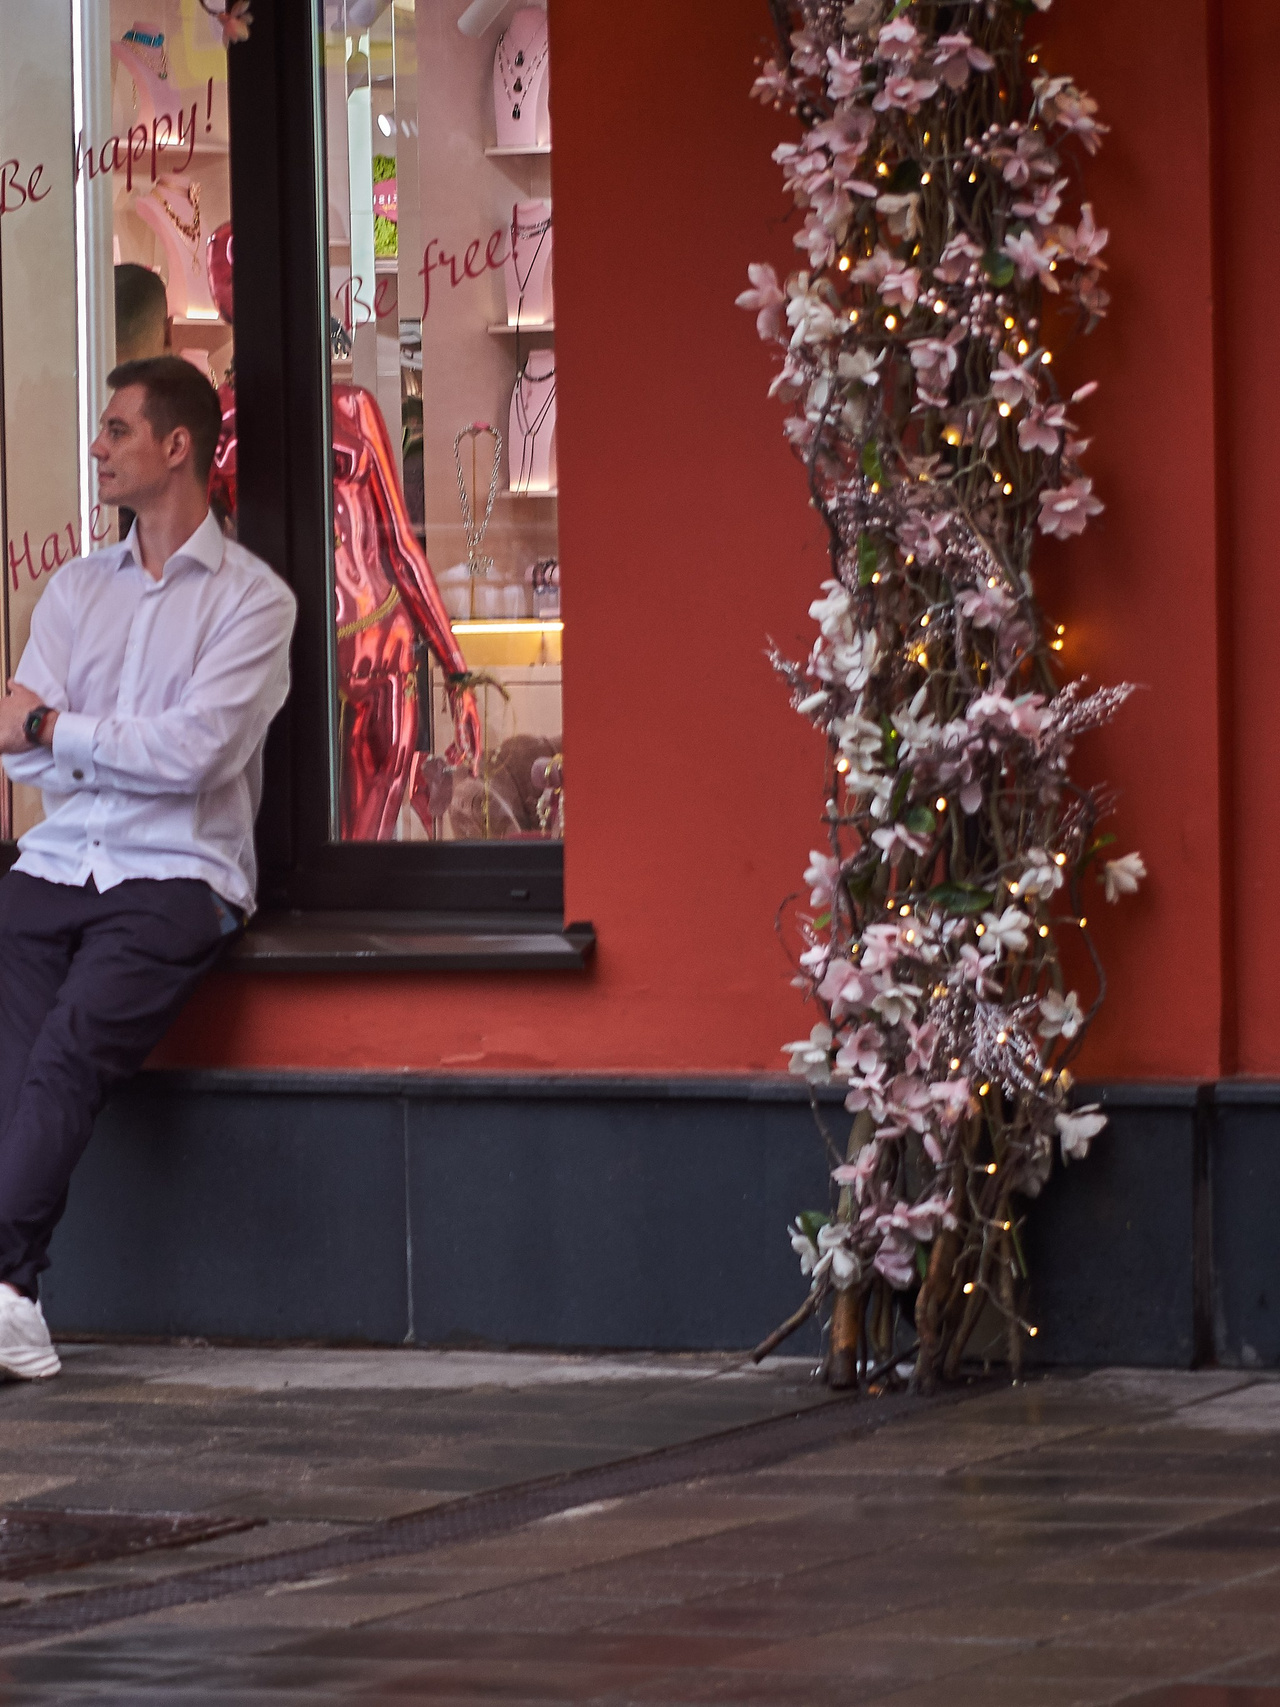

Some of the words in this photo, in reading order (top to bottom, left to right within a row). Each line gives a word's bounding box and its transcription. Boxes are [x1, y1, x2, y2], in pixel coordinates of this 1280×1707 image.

[75, 76, 213, 193] happy!
[335, 275, 397, 332] Be
[418, 202, 518, 321] free!
